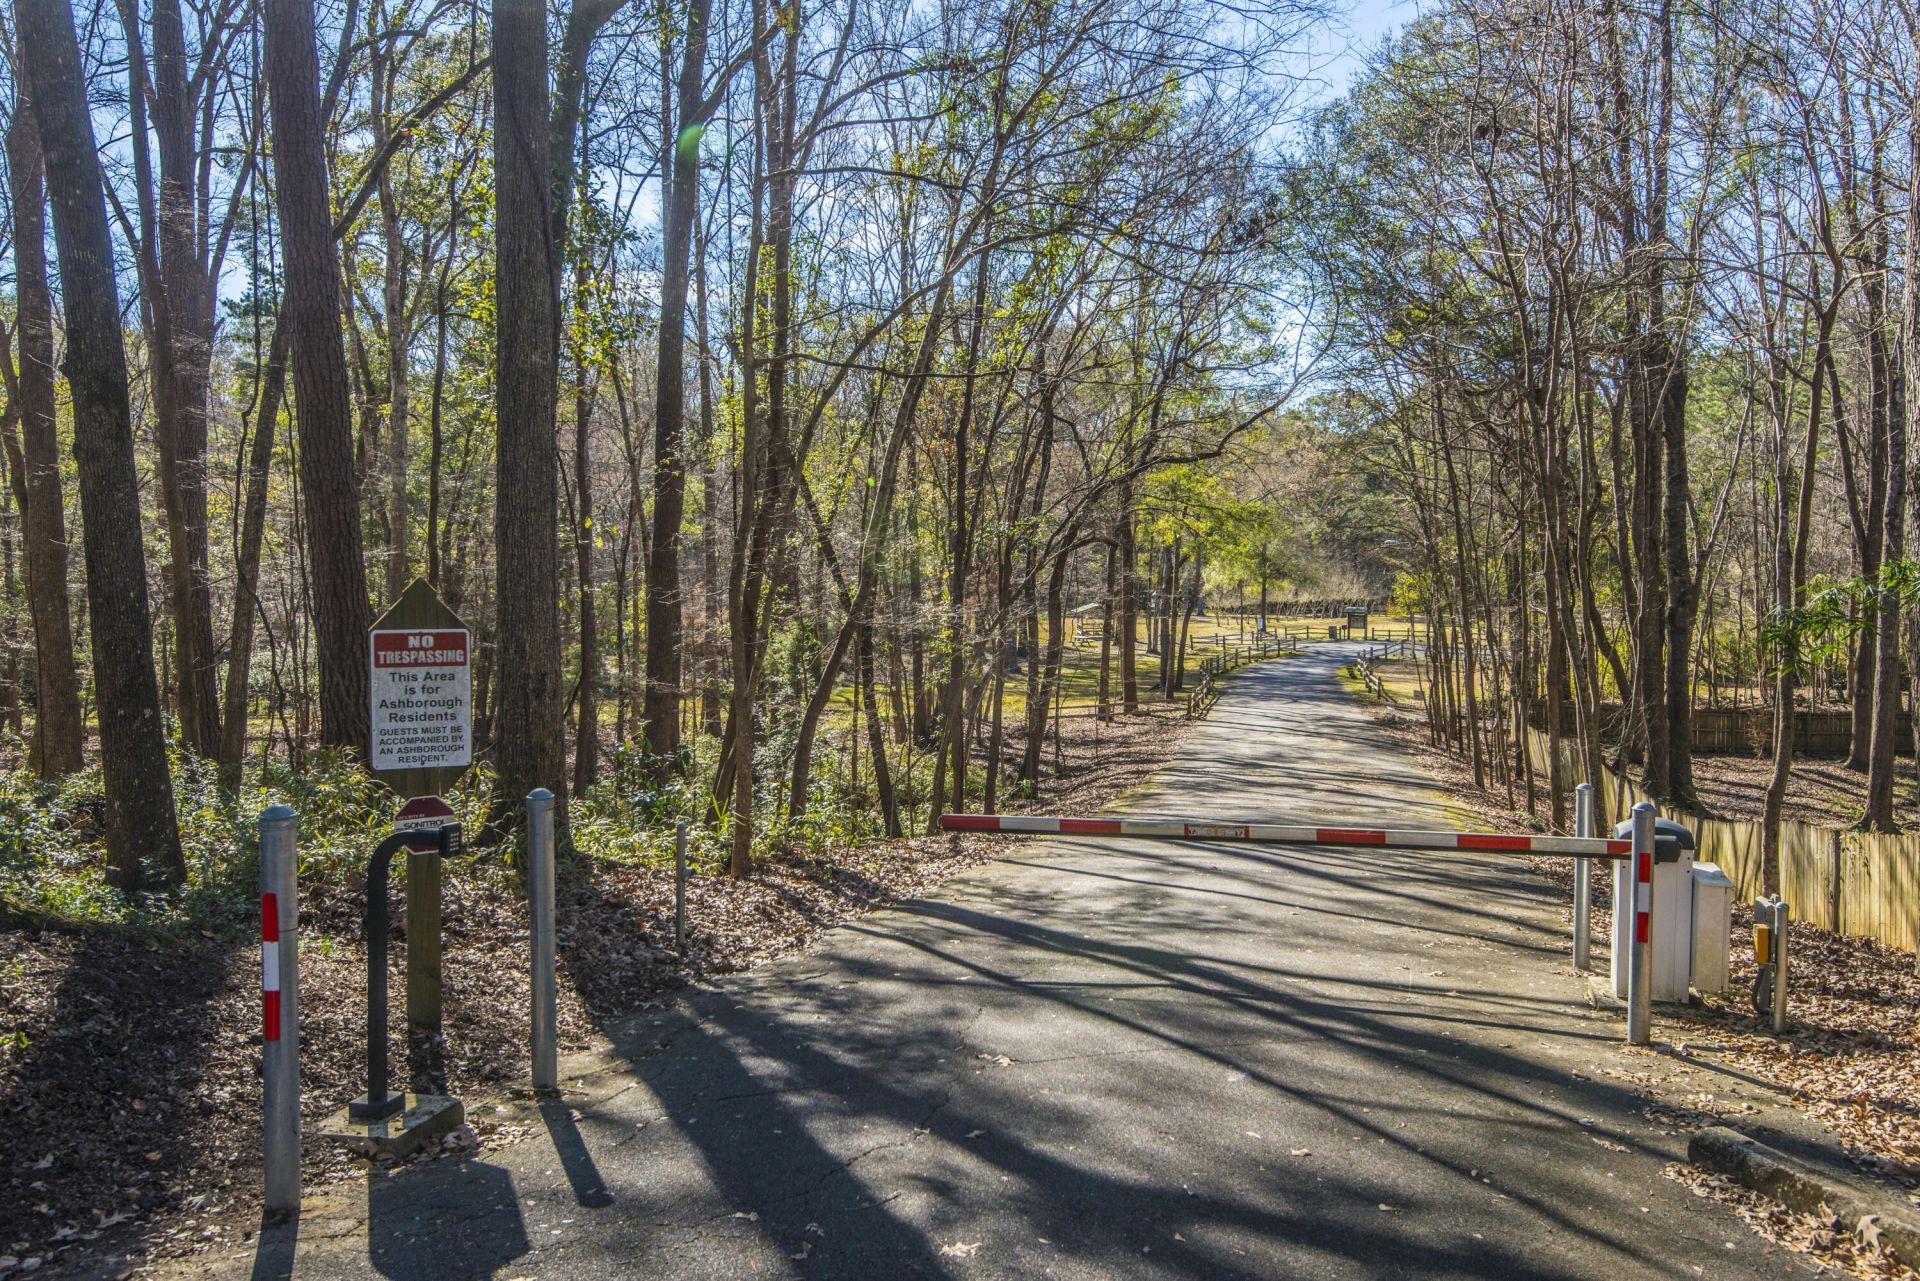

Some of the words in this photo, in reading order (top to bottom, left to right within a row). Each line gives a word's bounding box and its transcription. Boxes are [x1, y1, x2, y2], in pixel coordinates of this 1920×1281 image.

[408, 635, 434, 648] NO
[377, 650, 465, 664] TRESPASSING
[389, 672, 418, 683] This
[423, 671, 455, 682] Area
[404, 685, 416, 695] is
[421, 684, 440, 695] for
[379, 697, 463, 710] Ashborough
[388, 711, 457, 723] Residents
[379, 727, 419, 736] GUESTS
[421, 726, 447, 735] MUST
[450, 725, 463, 733] BE
[379, 736, 449, 746] ACCOMPANIED
[451, 735, 463, 743] BY
[379, 747, 394, 755] AN
[396, 744, 465, 755] ASHBOROUGH
